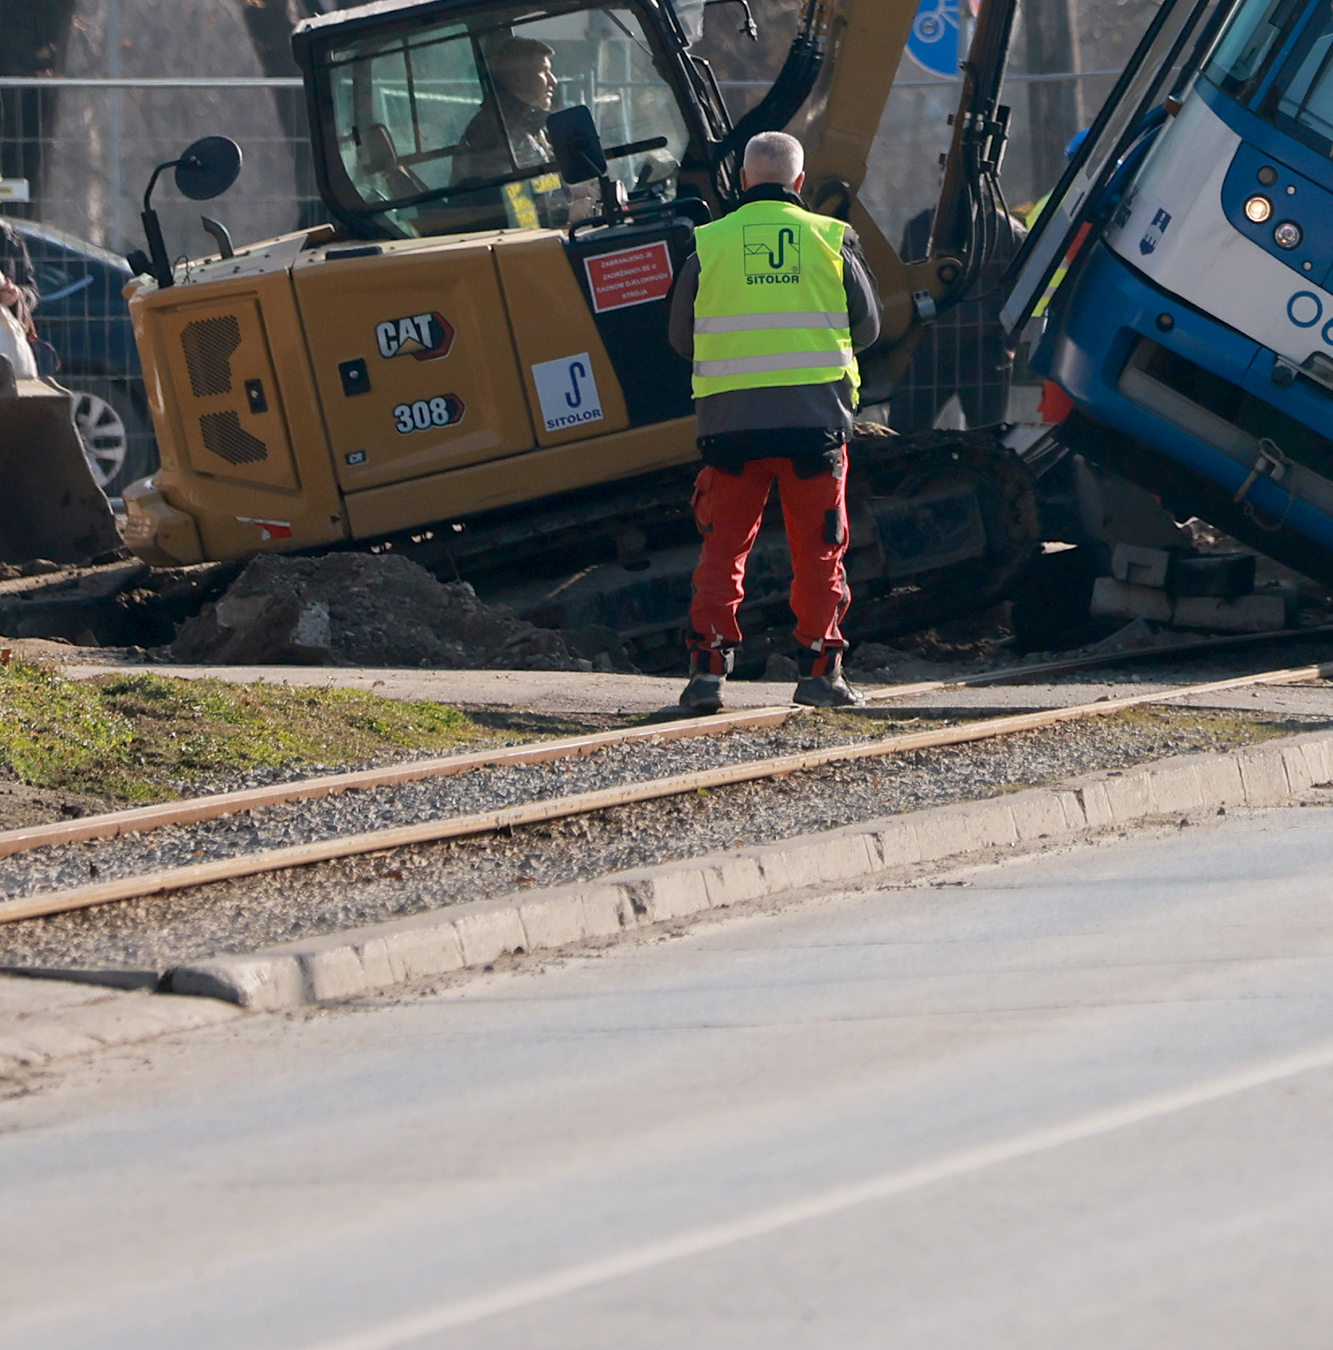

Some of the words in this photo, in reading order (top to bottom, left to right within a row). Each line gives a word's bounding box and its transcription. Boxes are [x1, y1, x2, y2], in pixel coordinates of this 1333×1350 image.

[746, 274, 800, 285] SITOLOR
[375, 314, 434, 358] CAT
[393, 396, 450, 434] 308
[546, 408, 602, 430] SITOLOR
